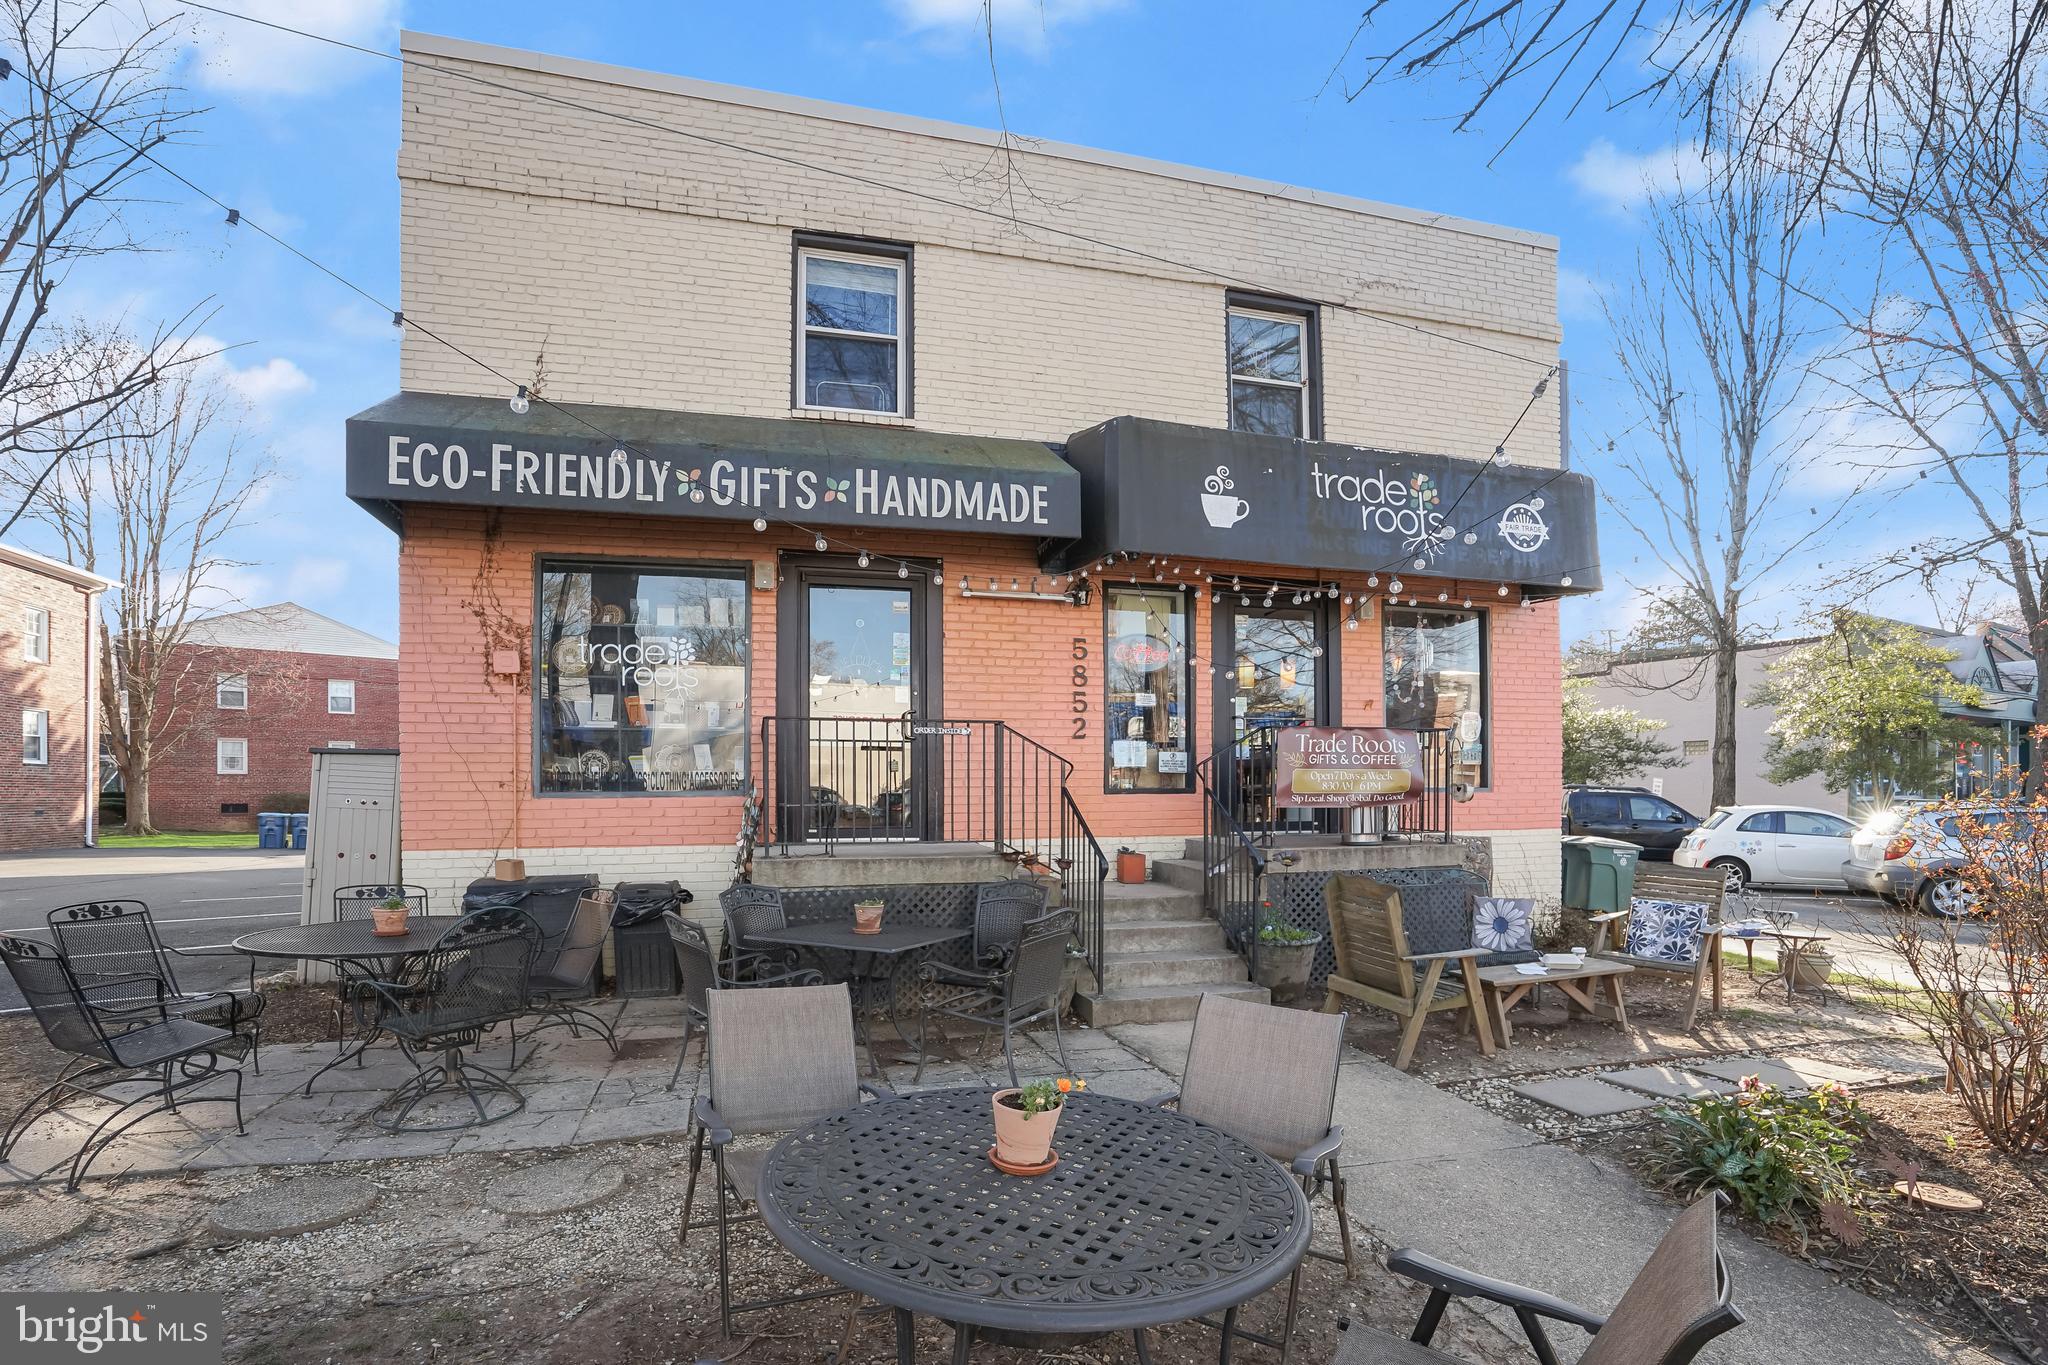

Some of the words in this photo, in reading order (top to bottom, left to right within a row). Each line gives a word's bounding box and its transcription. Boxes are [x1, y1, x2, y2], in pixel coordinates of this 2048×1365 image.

[388, 435, 671, 502] ECO-FRIENDLY
[709, 459, 818, 510] GIFTS
[855, 468, 1049, 525] HANDMADE
[1311, 462, 1408, 506] trade
[1361, 499, 1446, 539] roots
[1505, 523, 1520, 531] FAIR
[1522, 525, 1542, 534] TRADE
[578, 635, 665, 664] trade
[621, 661, 699, 688] roots
[1071, 637, 1088, 740] 5852
[913, 726, 937, 734] ORDER
[1295, 733, 1347, 753] Trade
[1351, 735, 1406, 753] Roots
[1309, 754, 1337, 765] GIFTS
[1340, 754, 1349, 765] &
[1351, 754, 1397, 765] COFFEE
[650, 772, 687, 791] CLOTHING
[689, 772, 740, 791] ACCESSORIES
[1310, 771, 1334, 782] Open
[1340, 771, 1360, 782] Days
[1361, 773, 1367, 781] a
[1367, 771, 1393, 780] Week
[1367, 781, 1382, 791] PM
[1291, 794, 1304, 804] Sip
[1326, 794, 1345, 804] Shop
[1373, 794, 1384, 802] Do
